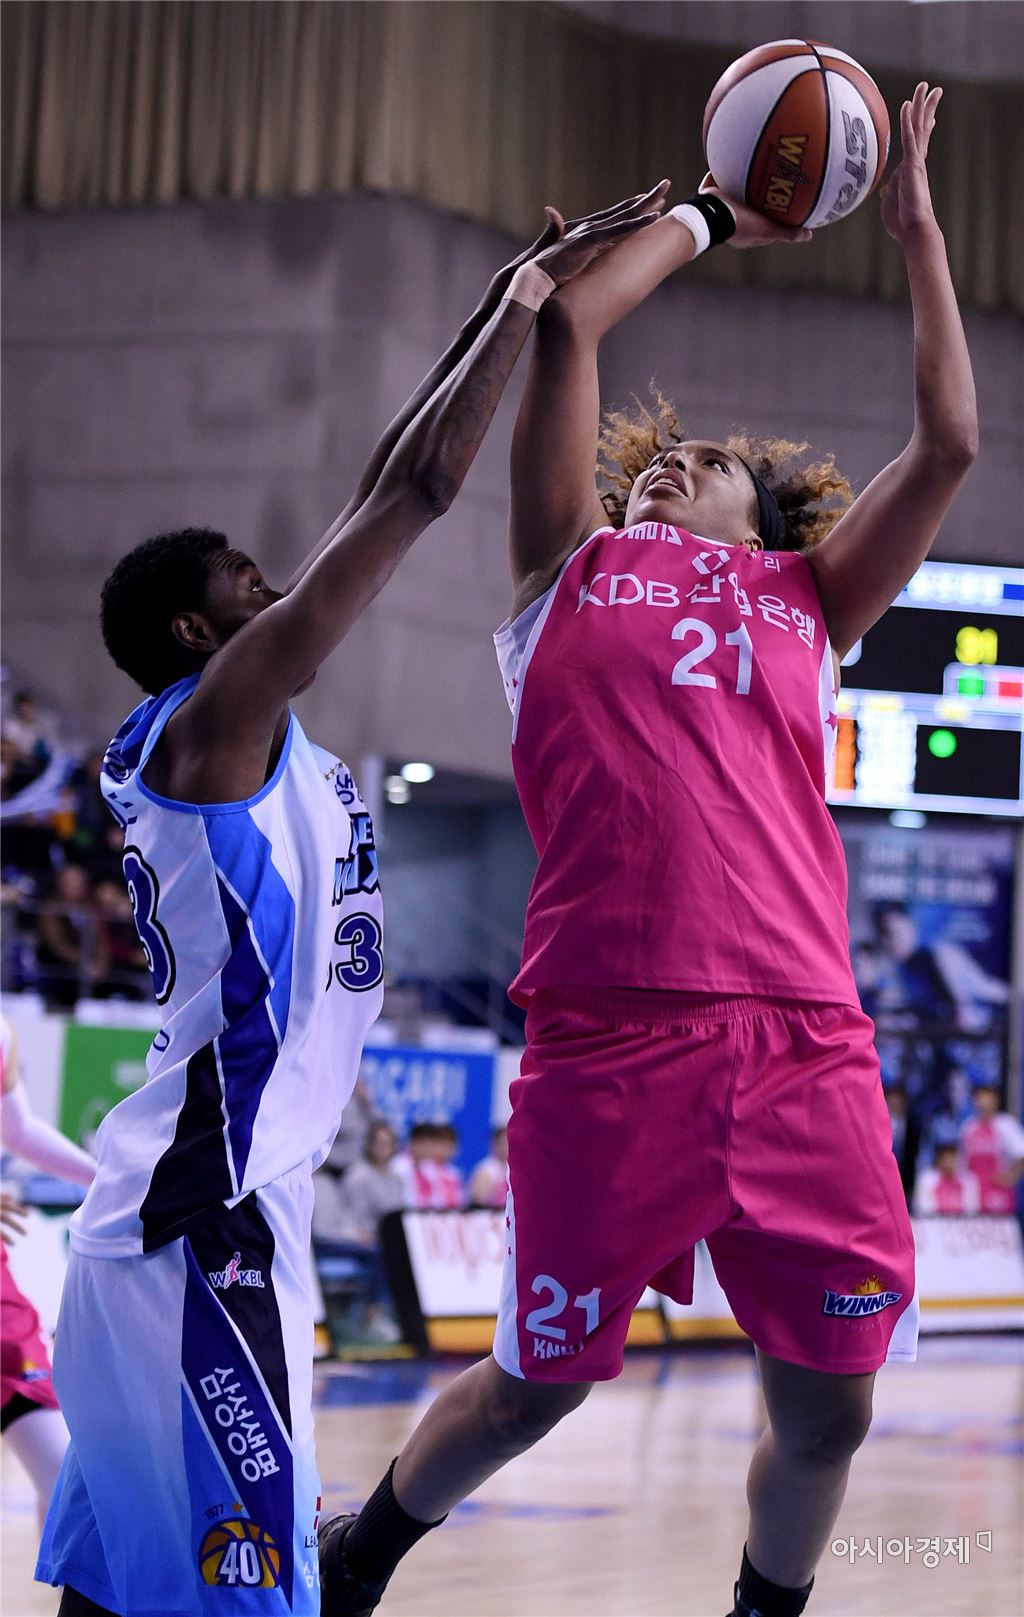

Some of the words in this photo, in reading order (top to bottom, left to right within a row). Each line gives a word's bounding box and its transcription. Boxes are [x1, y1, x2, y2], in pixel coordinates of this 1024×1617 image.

[671, 617, 754, 695] 21
[326, 911, 384, 993] 3
[525, 1274, 602, 1341] 21
[823, 1289, 902, 1316] WINNUS
[199, 1367, 281, 1483] 삼성생명
[220, 1540, 261, 1585] 40
